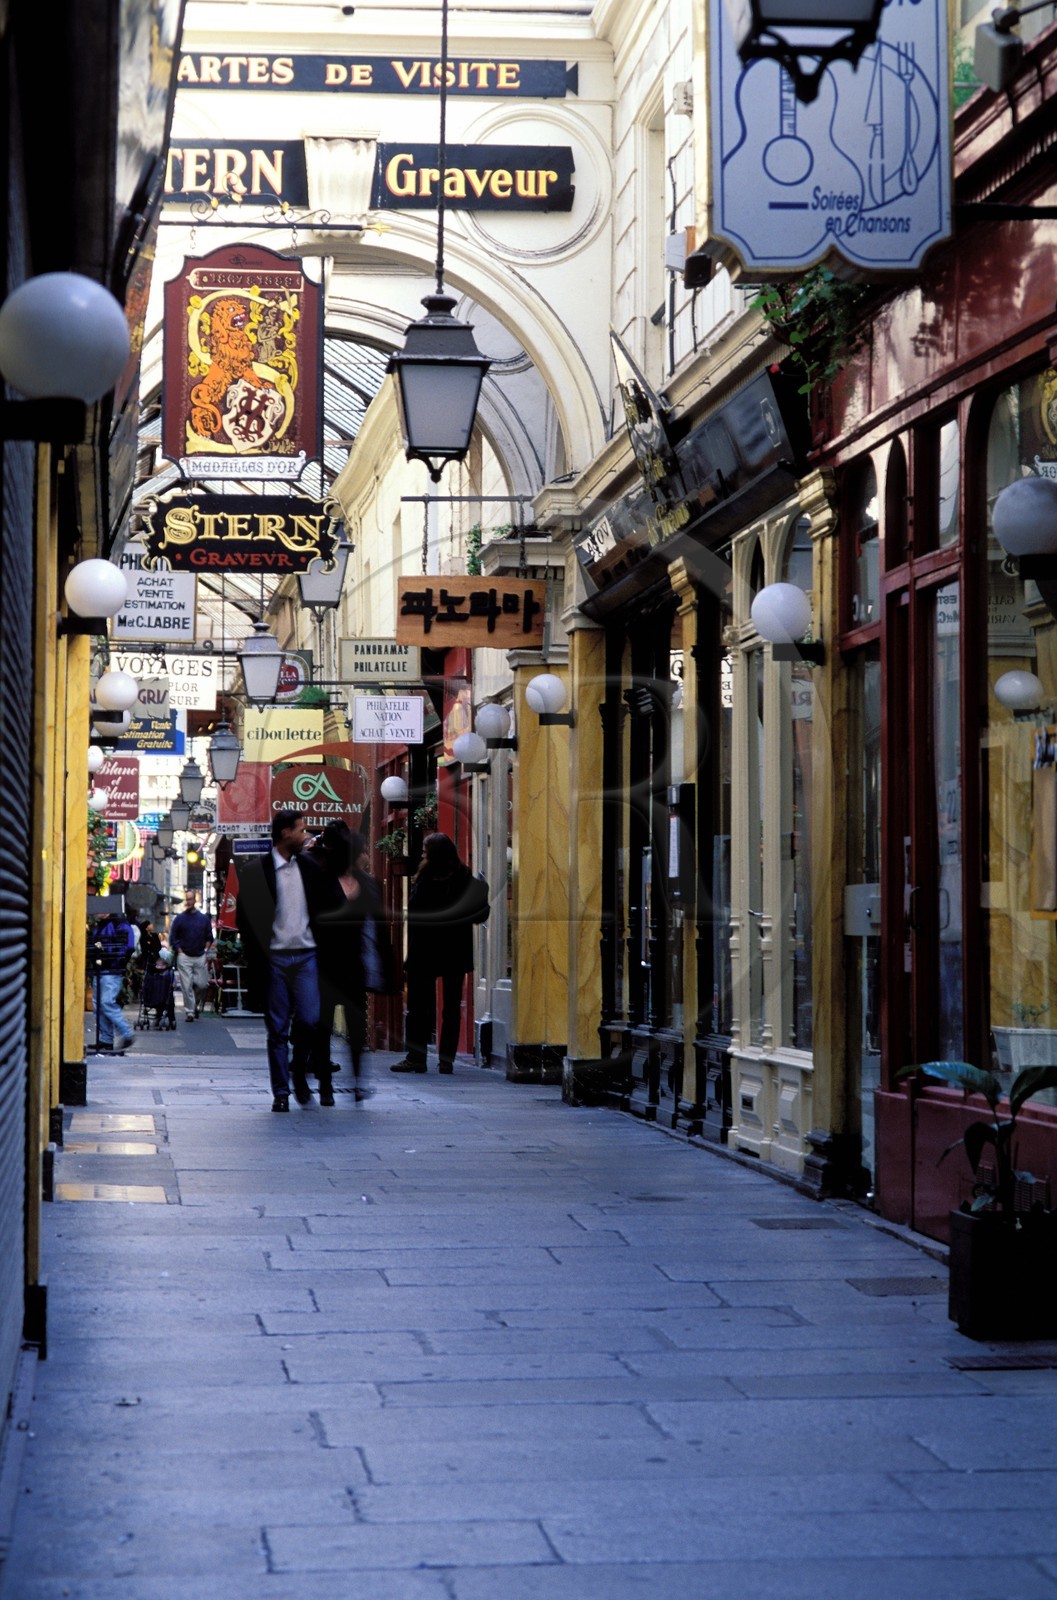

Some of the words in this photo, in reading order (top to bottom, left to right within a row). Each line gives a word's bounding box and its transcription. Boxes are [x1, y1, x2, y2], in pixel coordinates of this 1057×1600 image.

[325, 63, 373, 86] DE
[391, 60, 520, 89] VISITE
[164, 148, 284, 195] TERN
[385, 153, 558, 198] Graveur
[811, 186, 859, 211] Soirées
[826, 216, 842, 233] en
[846, 213, 911, 236] Chansons
[158, 504, 326, 554] STERN
[136, 577, 175, 588] ACHAT
[136, 589, 174, 600] VENTE
[124, 599, 186, 611] ESTIMATION
[400, 587, 541, 635] 파노라마
[353, 644, 409, 656] PANORAMAS
[115, 656, 214, 677] VOYAGES
[353, 661, 408, 673] PHILATELIE
[366, 701, 411, 712] PHILATELIE
[374, 712, 403, 722] NATION
[246, 727, 322, 741] ciboulette
[359, 728, 384, 739] ACHAT
[389, 728, 416, 738] VENTE
[136, 739, 174, 749] Gratuite
[96, 760, 138, 776] Blanc
[272, 800, 309, 812] CARIO
[312, 801, 362, 814] CEZKAM
[217, 824, 241, 833] ACHAT
